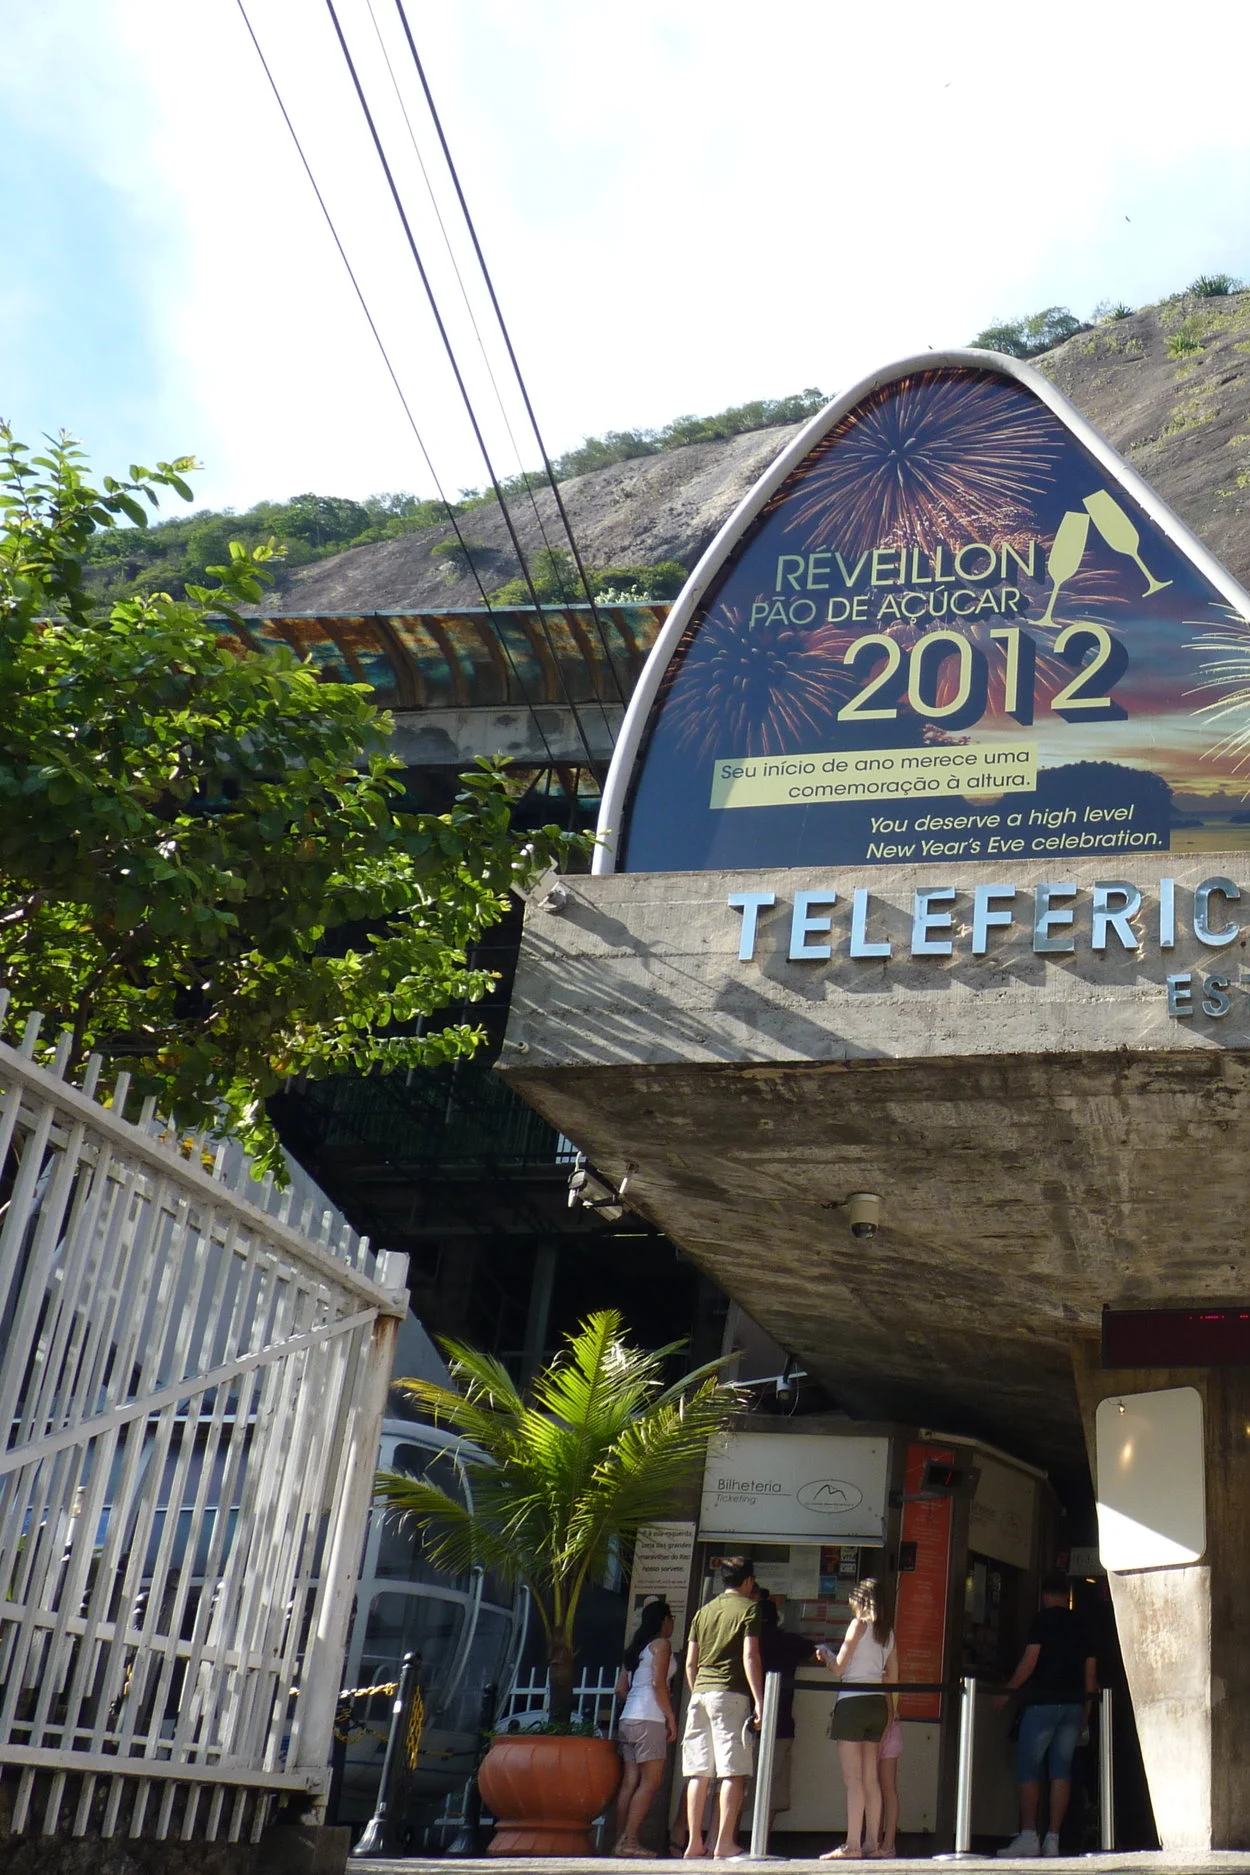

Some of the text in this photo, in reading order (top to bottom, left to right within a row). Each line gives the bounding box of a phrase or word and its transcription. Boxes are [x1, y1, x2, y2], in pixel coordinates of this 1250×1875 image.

[775, 541, 1035, 593] RÉVEILLON
[749, 585, 1021, 628] PÃO DE AÇÚCAR
[837, 622, 1112, 722] 2012
[720, 749, 1030, 780] Seu início de ano merece uma
[788, 773, 1031, 798] comemoração à altura.
[870, 804, 1135, 833] You deserve a high level
[866, 829, 1163, 859] New Year's Eve celebration.
[716, 1494, 757, 1505] Ticketing
[717, 1478, 782, 1493] Bilheteria
